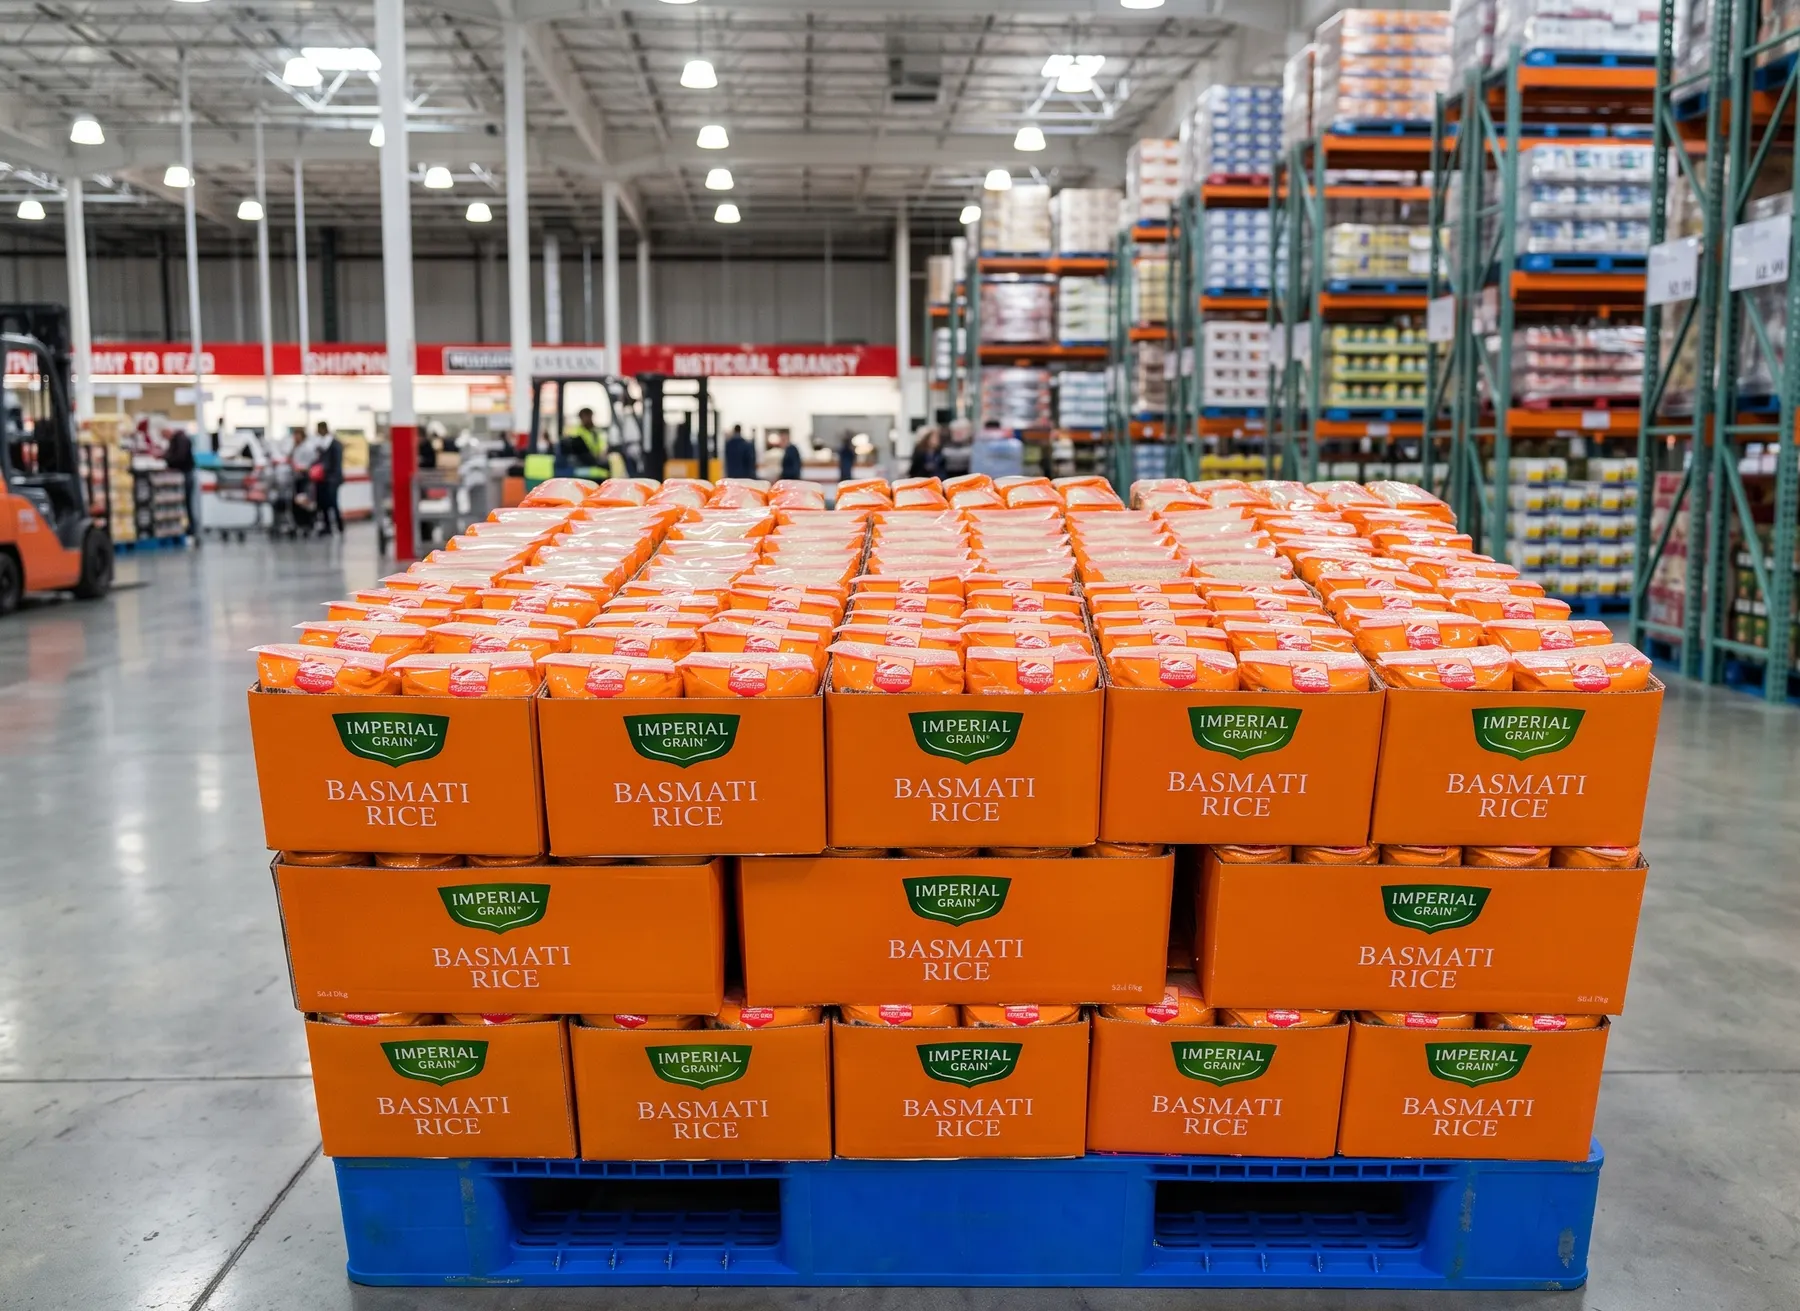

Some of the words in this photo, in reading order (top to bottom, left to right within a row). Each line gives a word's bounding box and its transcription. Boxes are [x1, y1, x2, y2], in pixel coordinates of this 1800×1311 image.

[346, 721, 438, 737] IMPERIAL
[637, 721, 729, 737] IMPERIAL
[922, 719, 1011, 733] IMPERIAL
[1200, 714, 1289, 729] IMPERIAL
[1483, 715, 1571, 730] IMPERIAL
[325, 779, 469, 804] BASMATI
[613, 780, 758, 803] BASMATI
[894, 777, 1035, 799] BASMATI
[1167, 771, 1308, 794] BASMATI
[1446, 773, 1587, 795] BASMATI
[365, 805, 437, 827] RICE
[930, 801, 1000, 822] RICE
[1201, 796, 1271, 817] RICE
[1478, 797, 1549, 818] RICE
[652, 806, 723, 827] RICE
[452, 891, 540, 906] IMPERIAL
[916, 883, 1000, 898] IMPERIAL
[1392, 892, 1477, 906] IMPERIAL
[432, 946, 571, 967] BASMATI
[888, 939, 1024, 959] BASMATI
[1357, 946, 1495, 968] BASMATI
[470, 969, 540, 989] RICE
[923, 961, 990, 981] RICE
[1389, 969, 1457, 989] RICE
[394, 1046, 479, 1060] IMPERIAL
[658, 1051, 742, 1064] IMPERIAL
[929, 1049, 1012, 1062] IMPERIAL
[1182, 1048, 1265, 1062] IMPERIAL
[1435, 1048, 1518, 1062] IMPERIAL
[376, 1096, 510, 1115] BASMATI
[637, 1099, 768, 1120] BASMATI
[903, 1098, 1033, 1117] BASMATI
[1151, 1095, 1283, 1116] BASMATI
[1402, 1097, 1535, 1117] BASMATI
[414, 1117, 481, 1135] RICE
[673, 1121, 739, 1139] RICE
[935, 1119, 1001, 1137] RICE
[1183, 1117, 1249, 1136] RICE
[1433, 1118, 1498, 1137] RICE
